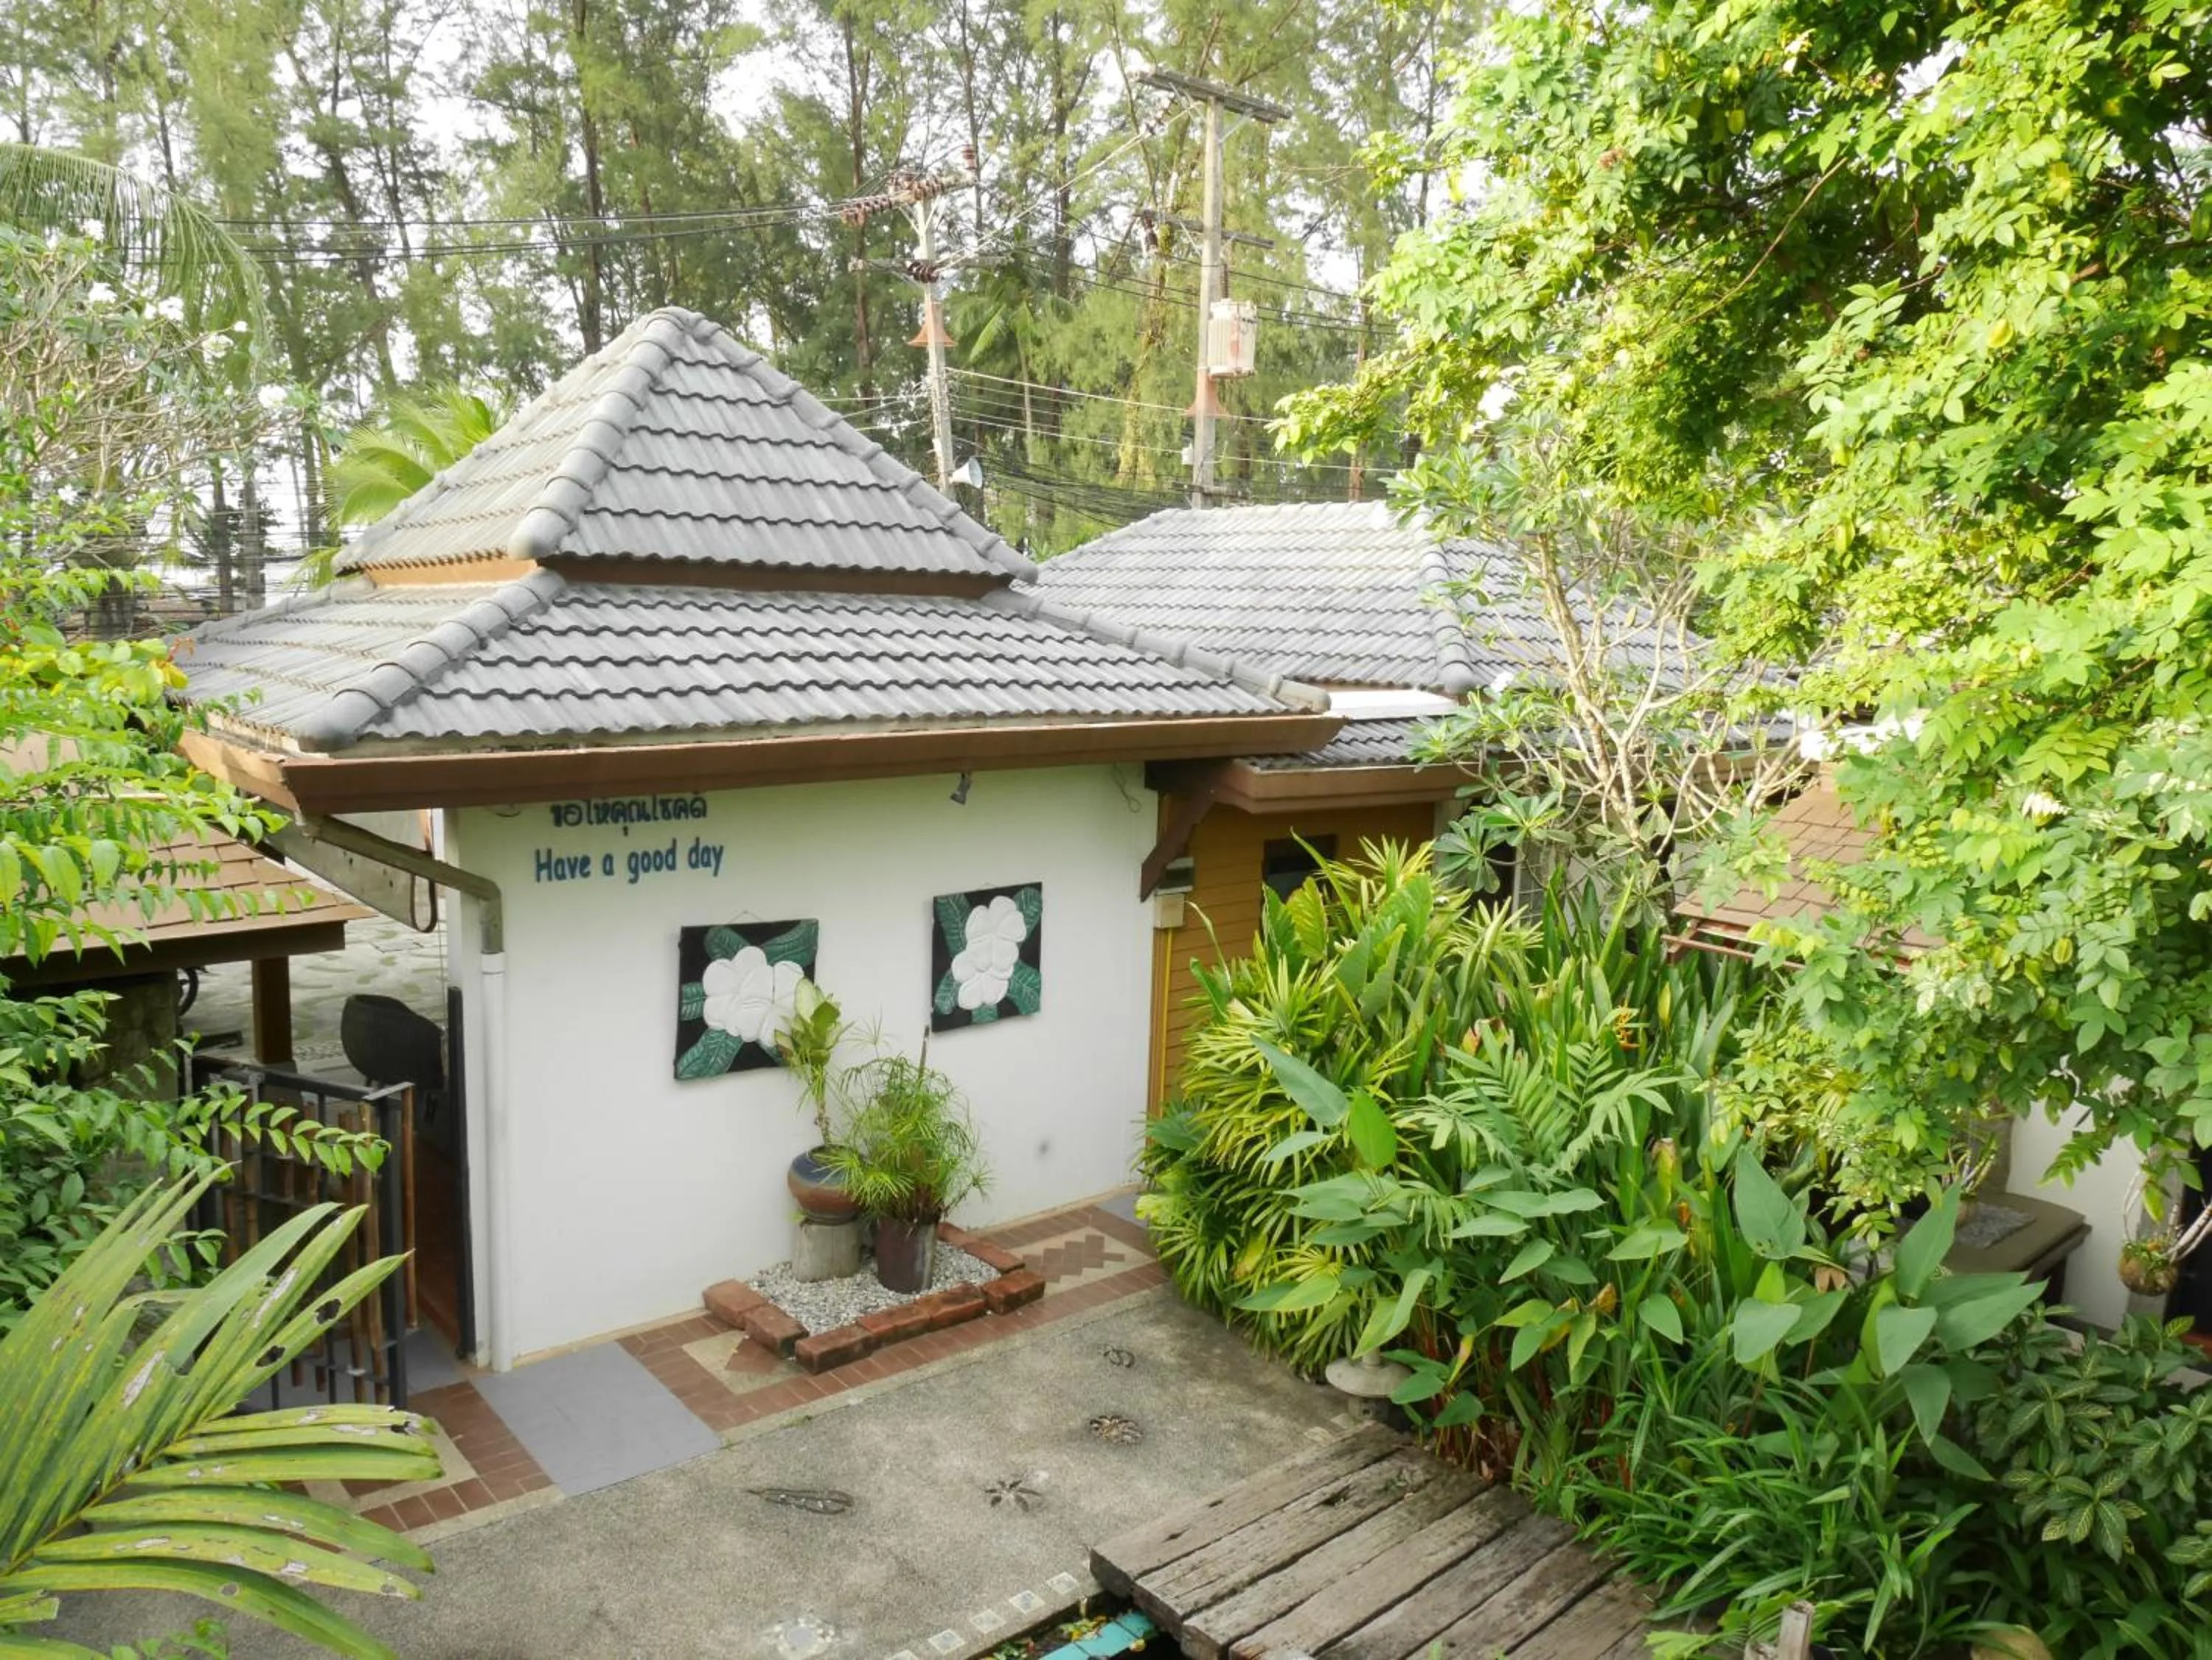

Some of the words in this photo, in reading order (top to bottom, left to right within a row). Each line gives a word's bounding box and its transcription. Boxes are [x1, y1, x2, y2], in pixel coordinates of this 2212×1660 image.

[535, 848, 591, 882] Have
[602, 853, 614, 876] a
[627, 837, 677, 885] good
[688, 837, 724, 877] day
